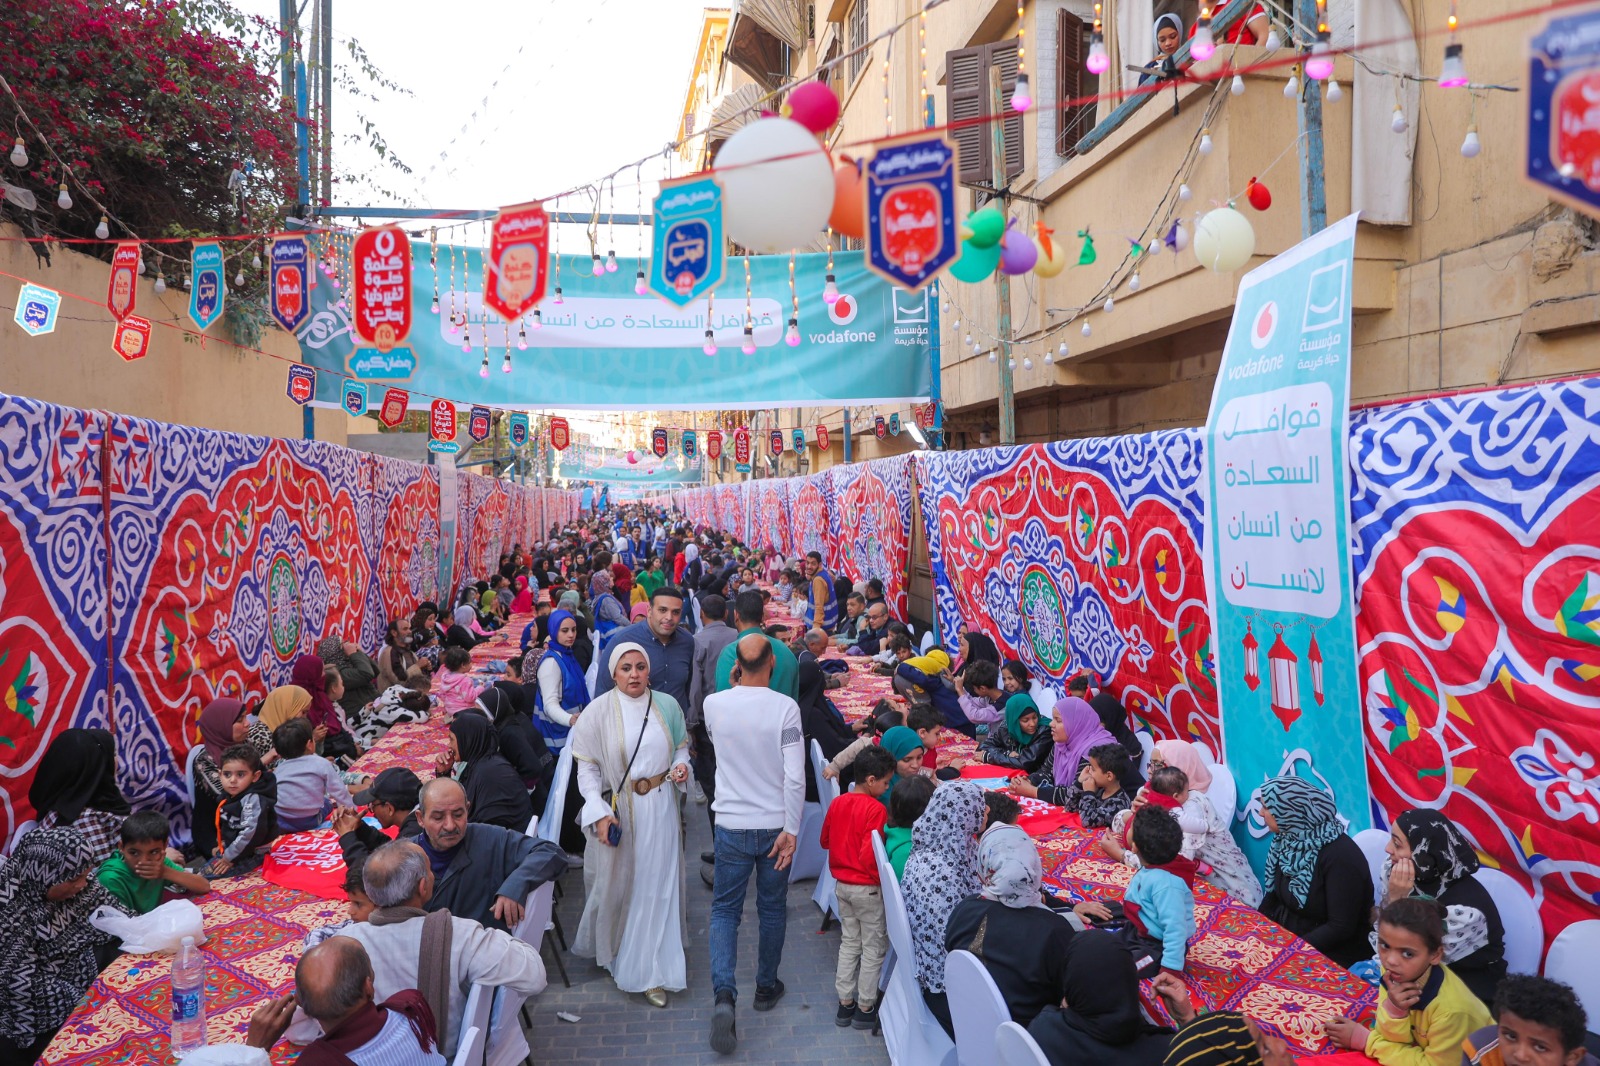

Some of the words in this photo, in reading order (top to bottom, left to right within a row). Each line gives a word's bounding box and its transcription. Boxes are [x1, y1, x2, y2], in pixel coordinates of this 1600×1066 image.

[363, 255, 404, 273] كلمة
[364, 271, 404, 288] حلوة
[585, 315, 615, 330] من
[622, 314, 704, 329] السعادة
[712, 312, 774, 331] قوافل
[809, 329, 877, 345] vodafone
[893, 325, 929, 338] مؤسسة
[894, 338, 916, 347] كريمة
[916, 337, 929, 345] حياة
[1299, 331, 1342, 353] مؤسسة
[355, 355, 386, 372] كريم
[1228, 353, 1284, 380] vodafone
[1297, 355, 1324, 371] كريمة
[1324, 353, 1340, 367] حياة
[1222, 402, 1321, 441] قوافل
[1224, 455, 1320, 488] السعادة
[1227, 510, 1280, 541] انسان
[1290, 516, 1323, 543] من
[1230, 561, 1325, 595] لانسان
